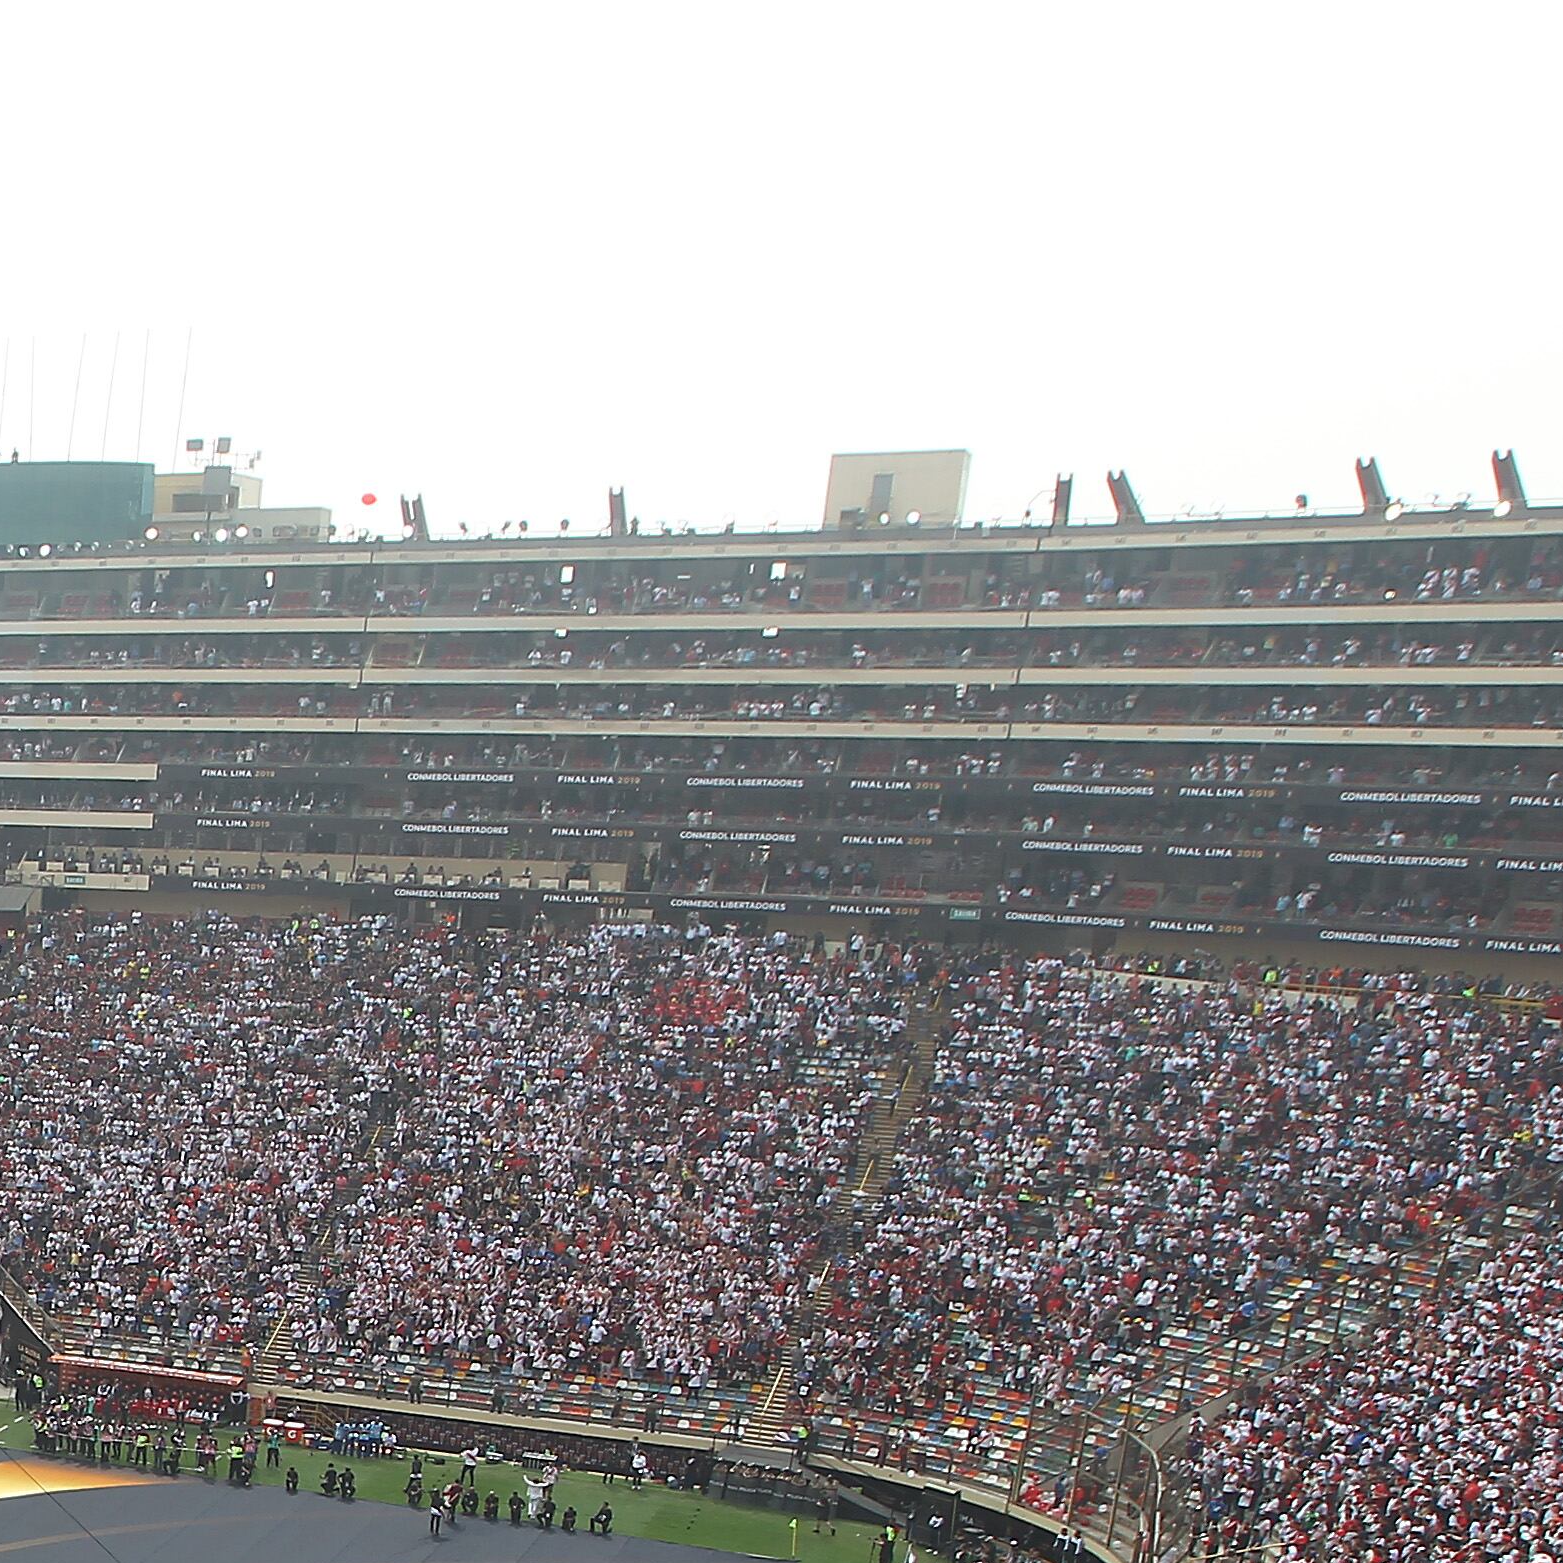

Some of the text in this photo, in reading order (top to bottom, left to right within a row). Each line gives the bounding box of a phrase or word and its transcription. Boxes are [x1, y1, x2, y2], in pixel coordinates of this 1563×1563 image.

[201, 769, 228, 778] FINAL
[230, 769, 253, 778] LIMA
[407, 772, 514, 783] CONMEBOL LIBERTADORES
[557, 774, 641, 785] FINAL LIMA 2019
[686, 777, 804, 789] CONMEBOL LIBERTADORES
[850, 780, 942, 791] FINAL LIMA 2019
[1033, 782, 1155, 797] CONMEBOL LIBERTADORES
[1179, 787, 1275, 799] FINAL LIMA 2019
[1340, 791, 1482, 805] CONMEBOL LIBERTADORES
[1509, 795, 1550, 806] FINAL
[196, 818, 224, 827] FINAL
[224, 819, 248, 828] LIMA
[402, 823, 509, 836] CONMEBOL LIBERTADORES
[551, 828, 635, 838] FINAL LIMA 2019
[679, 830, 797, 843] CONMEBOL LIBERTADORES
[842, 835, 933, 846] FINAL LIMA 2019
[1022, 840, 1144, 854] CONMEBOL LIBERTADORES
[1166, 846, 1263, 859] FINAL LIMA 2019
[1327, 852, 1469, 869] CONMEBOL LIBERTADORES
[1496, 859, 1563, 872] FINAL LIM
[192, 881, 220, 890] FINAL
[220, 881, 243, 890] LIMA
[394, 888, 500, 902] CONMEBOL LIBERTADORES
[542, 894, 625, 905] FINAL LIMA 2019
[670, 898, 786, 911] CONMEBOL LIBERTADORES
[829, 905, 921, 916] FINAL LIMA 2019
[1005, 911, 1125, 928] CONMEBOL LIBERTADORES
[1149, 919, 1244, 934] FINAL LIMA 2019
[1319, 929, 1460, 949] CONMEBOL LIBERTADORES
[1485, 940, 1561, 953] FINAL LIMA
